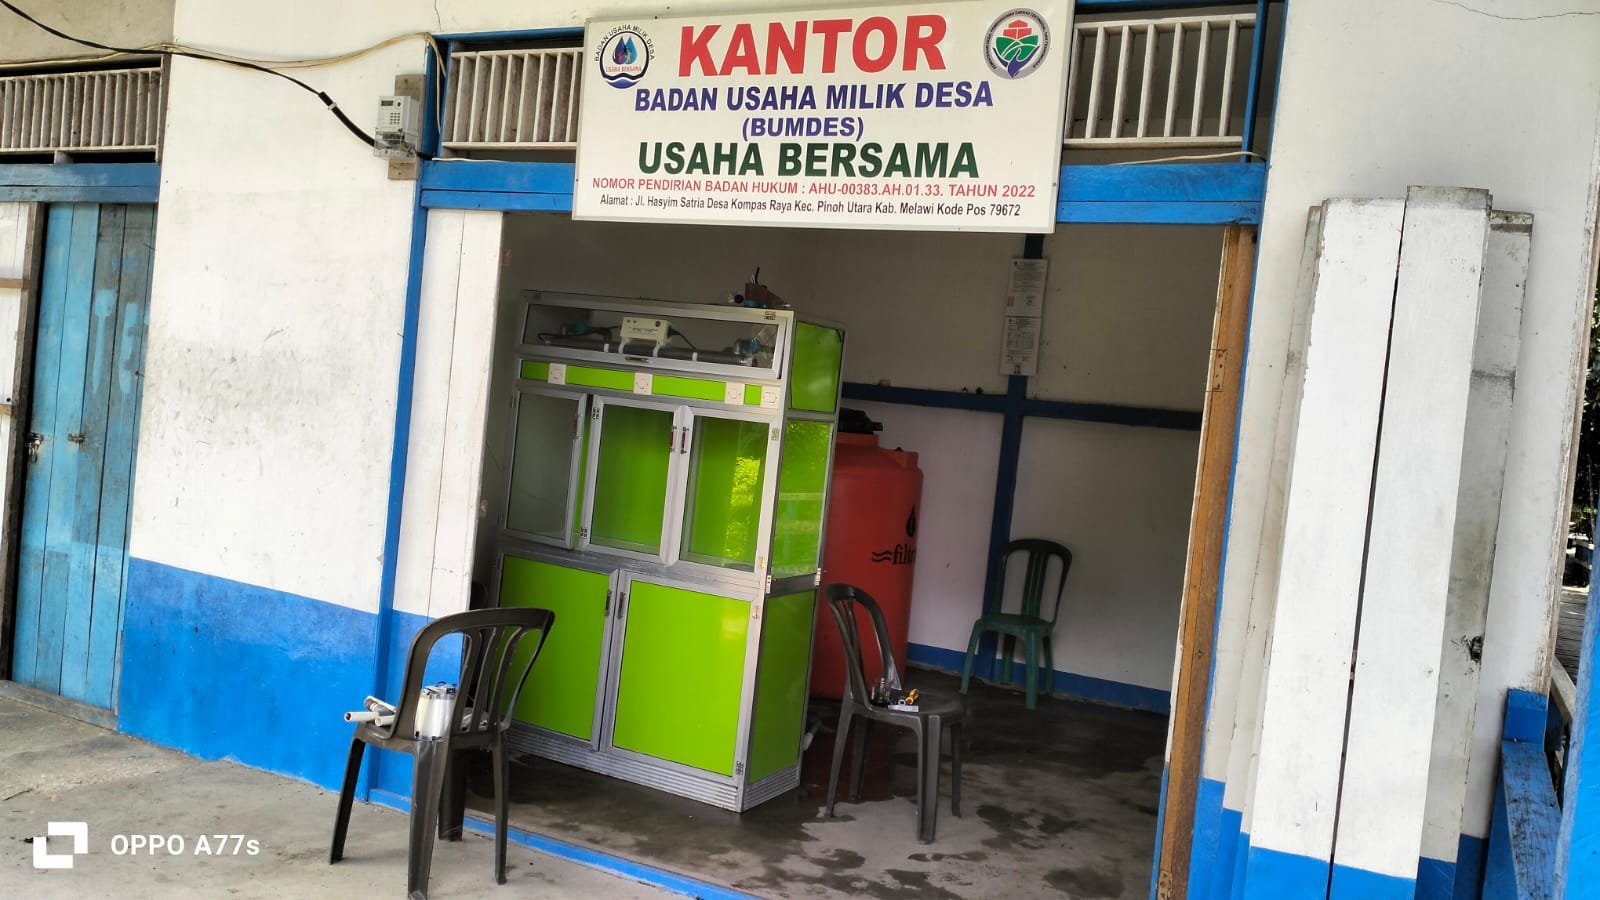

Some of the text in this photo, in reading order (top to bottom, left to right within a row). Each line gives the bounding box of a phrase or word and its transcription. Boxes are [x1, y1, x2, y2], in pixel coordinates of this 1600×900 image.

[594, 24, 656, 62] BADAN USAHA MILIK DESA
[678, 14, 947, 77] KANTOR
[634, 80, 994, 112] BADAN USAHA MILIK DESA
[742, 117, 864, 142] (BUMDES)
[638, 141, 980, 179] USAHA BERSAMA
[592, 177, 635, 190] NOMOR
[638, 179, 701, 191] PENDIRIAN
[705, 180, 748, 193] BADAN
[751, 181, 798, 194] HUKUM
[808, 182, 944, 197] AHU-00383.AH.01.33.
[949, 183, 998, 198] TAHUN
[1002, 185, 1036, 198] 2022
[600, 194, 628, 206] Alamat
[635, 195, 645, 206] Jl.
[647, 195, 678, 209] Hasyim
[680, 196, 705, 208] Satria
[707, 197, 729, 209] Desa
[731, 198, 767, 212] Kompas
[769, 199, 792, 213] Raya
[794, 199, 814, 212] Kec.
[817, 200, 844, 213] Pinoh
[847, 201, 872, 213] Utara
[875, 202, 897, 214] Kab.
[899, 202, 934, 215] Melawi
[937, 203, 963, 215] Kode
[966, 203, 986, 216] Pos
[989, 204, 1021, 217] 79672
